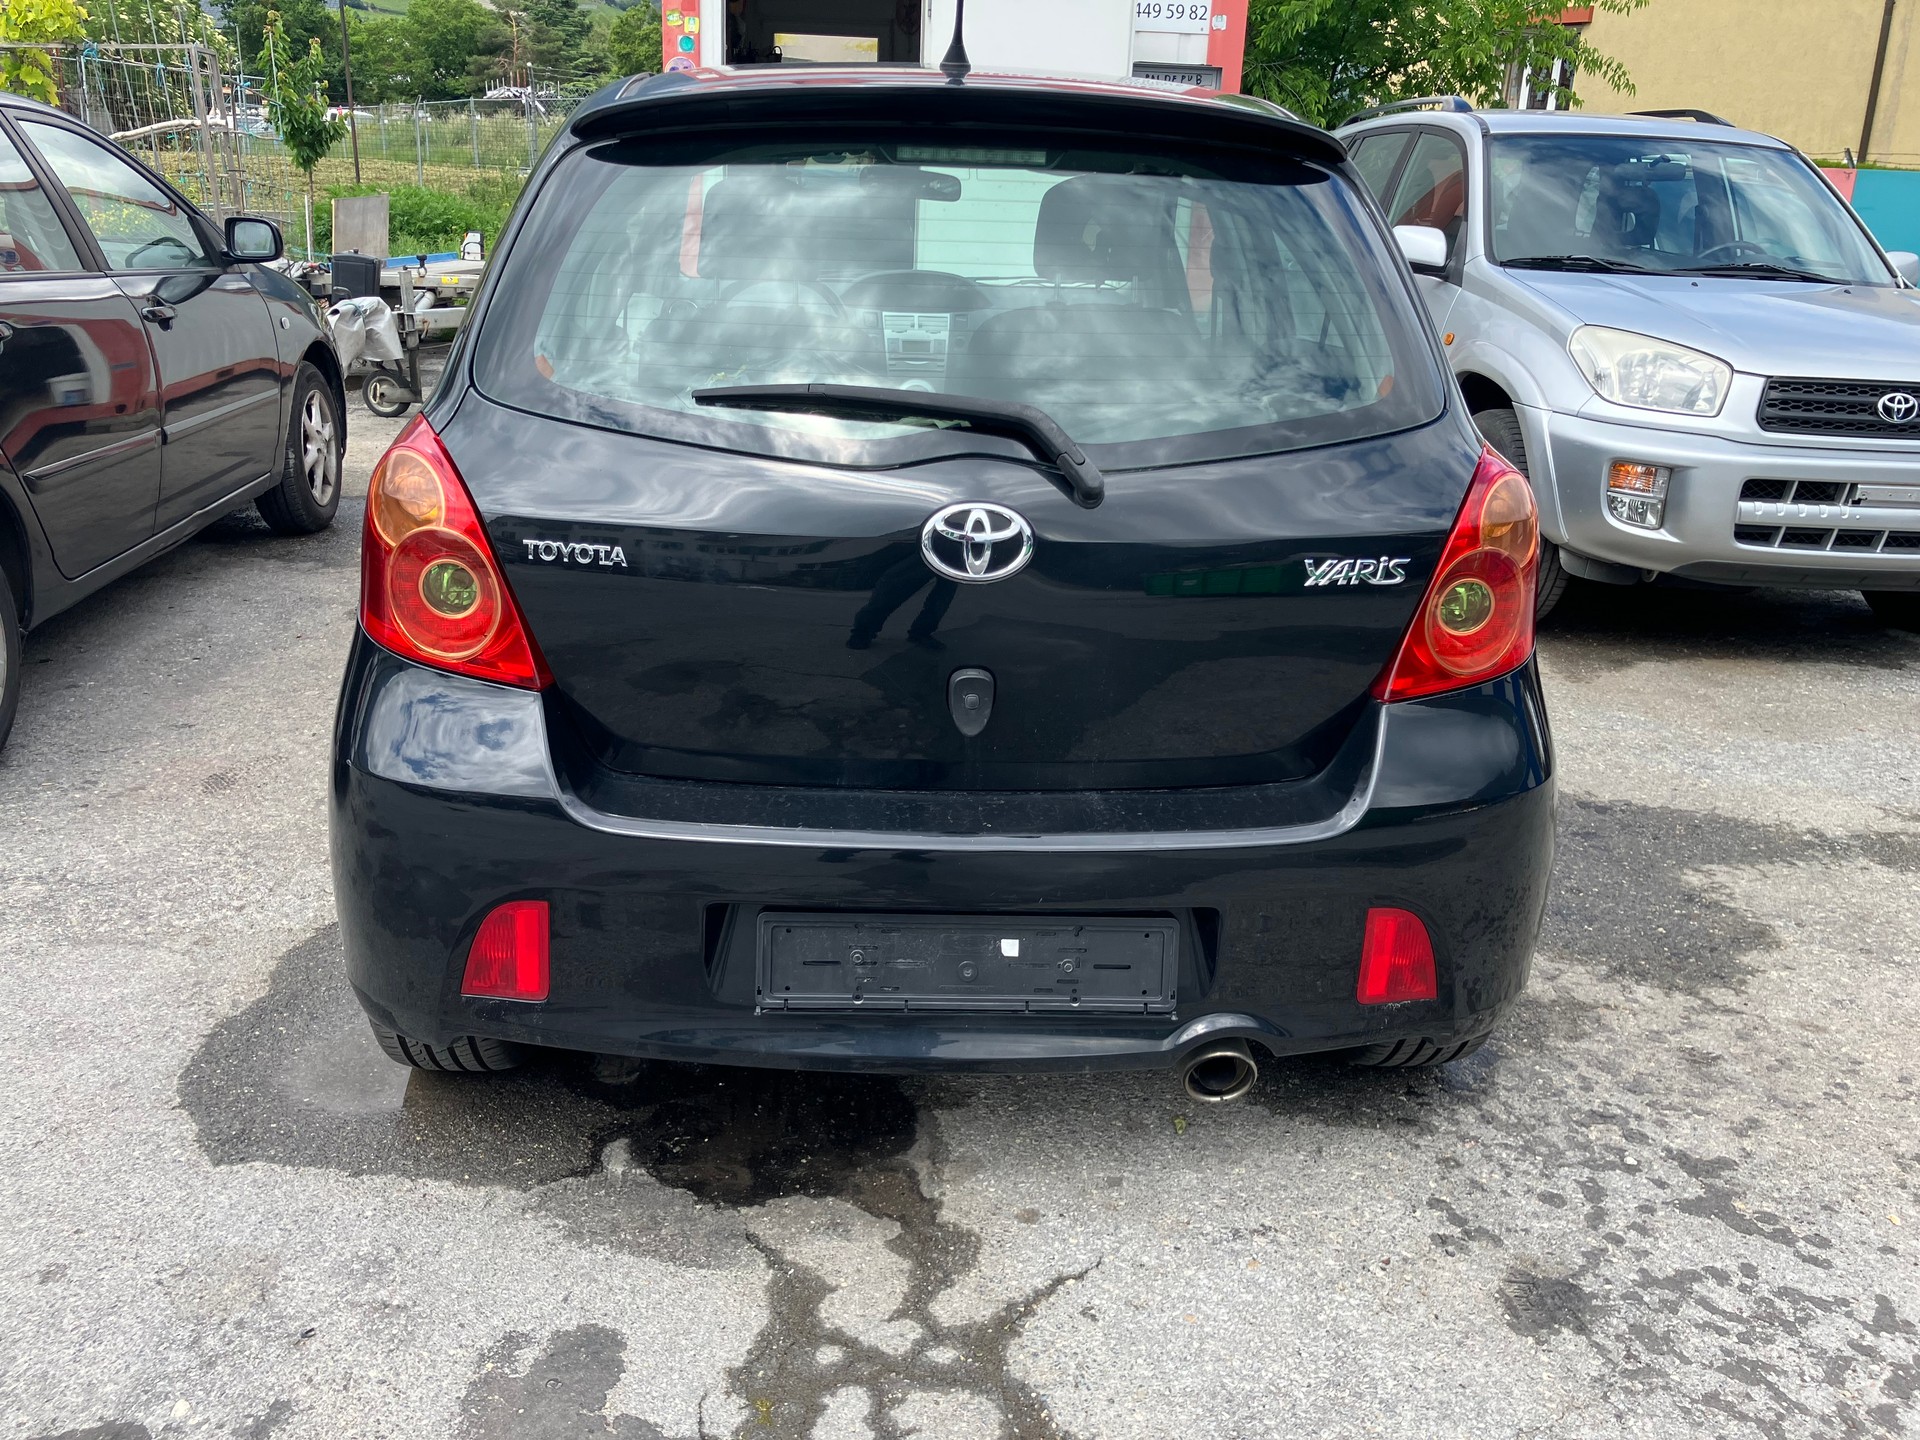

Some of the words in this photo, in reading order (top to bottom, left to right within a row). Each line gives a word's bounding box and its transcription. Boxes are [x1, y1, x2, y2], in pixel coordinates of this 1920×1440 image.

[1166, 3, 1185, 20] 59
[1189, 4, 1208, 21] 82
[1180, 73, 1203, 85] PUB
[522, 539, 628, 567] TOYOTA
